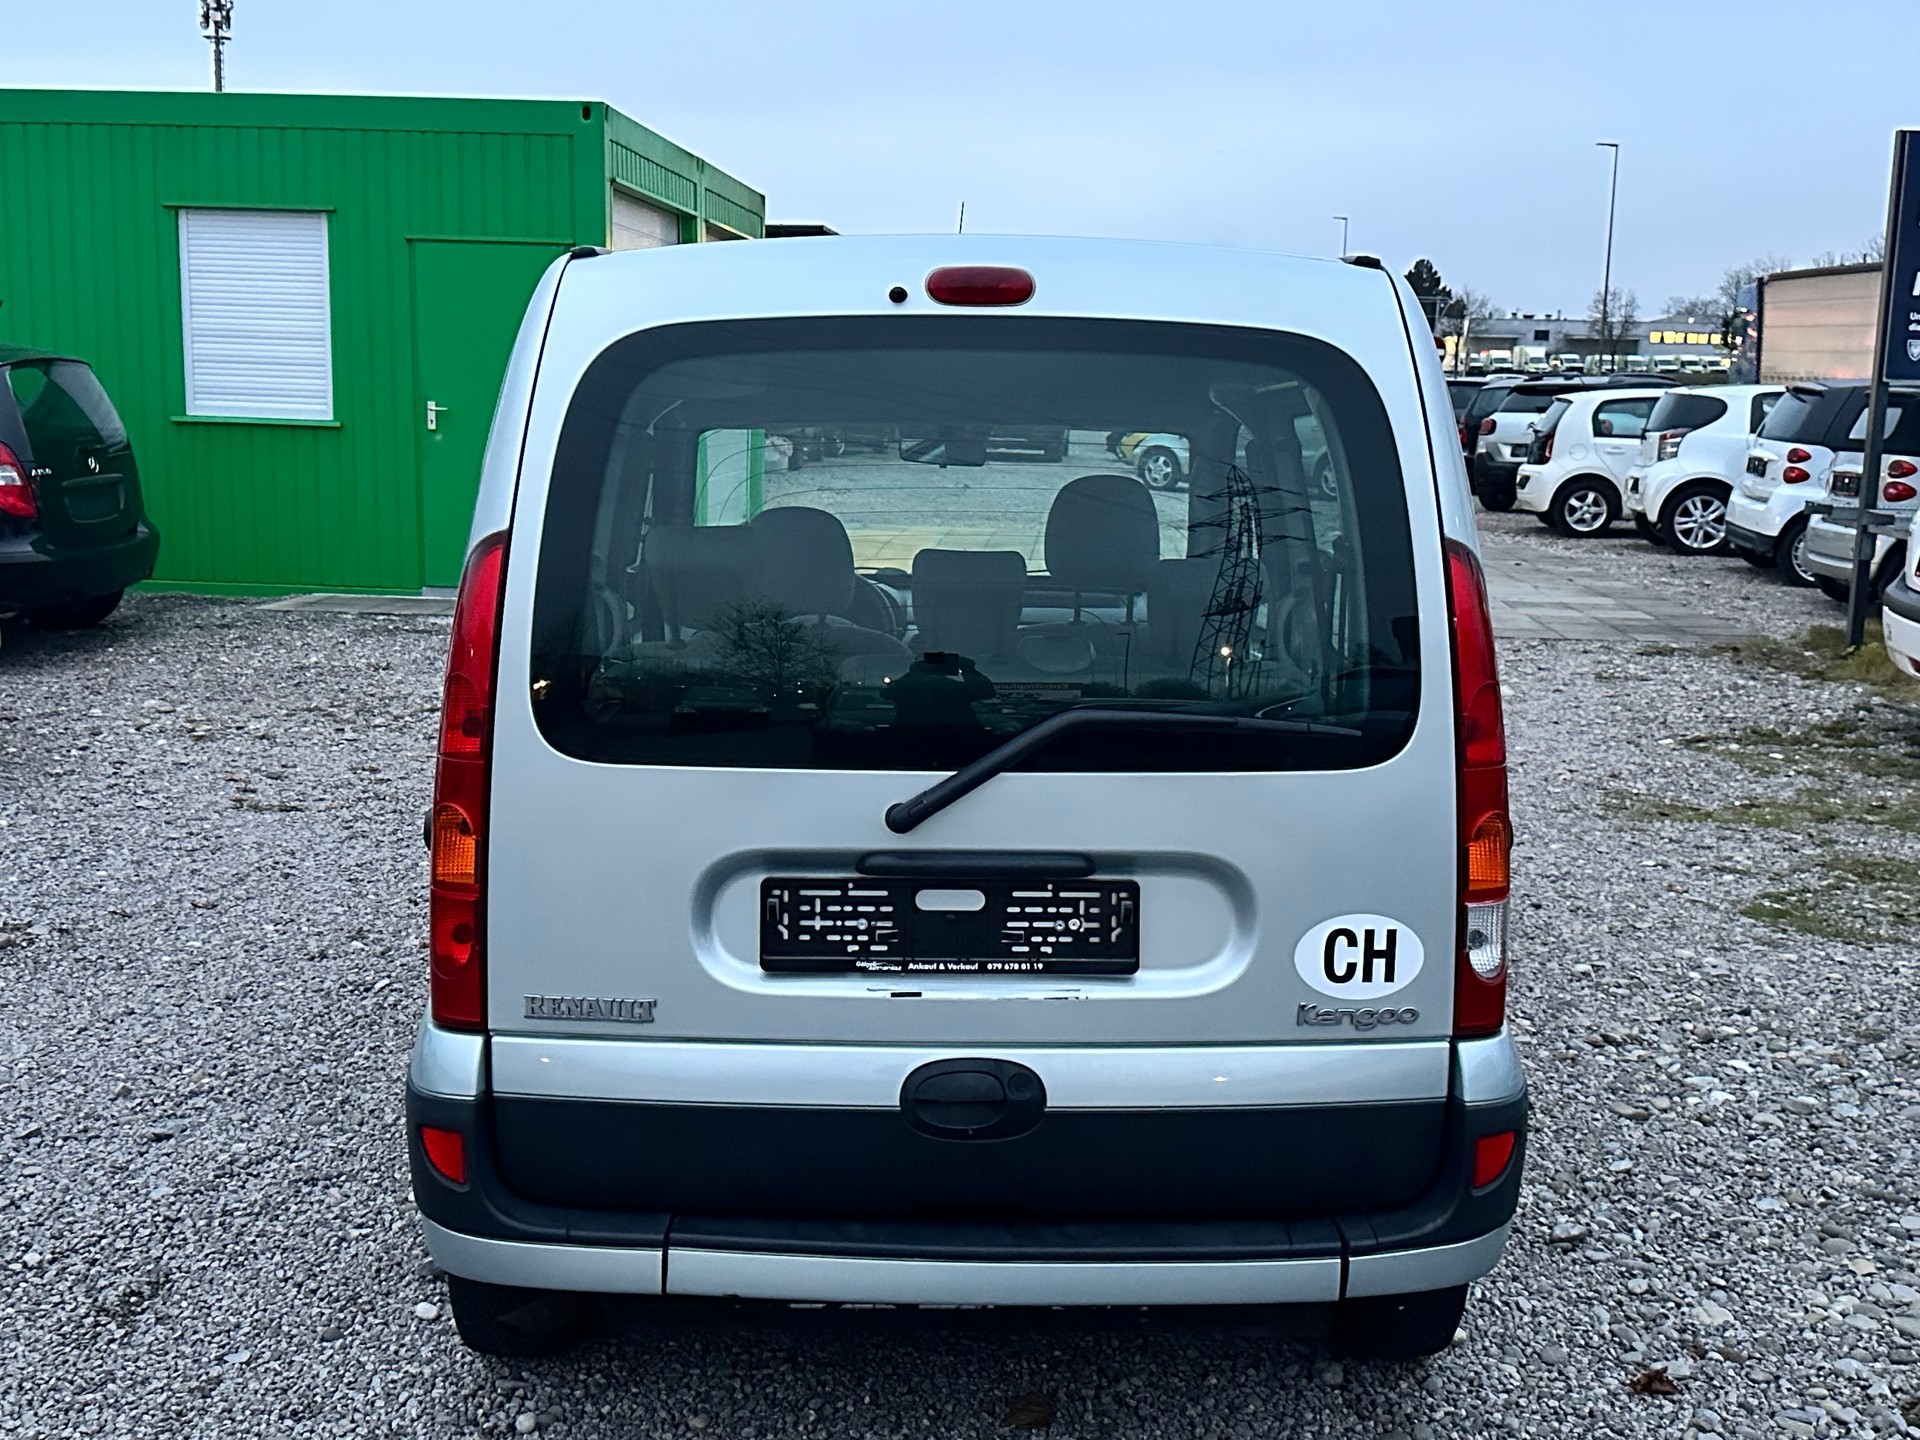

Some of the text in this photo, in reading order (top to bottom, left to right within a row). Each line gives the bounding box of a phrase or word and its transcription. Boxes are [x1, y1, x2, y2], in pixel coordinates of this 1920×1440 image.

[907, 962, 1044, 970] Ankauf & Verkauf 079 678 01 19
[1323, 927, 1398, 984] CH
[523, 993, 658, 1024] RENAULT
[1296, 1002, 1421, 1032] Kangoo
